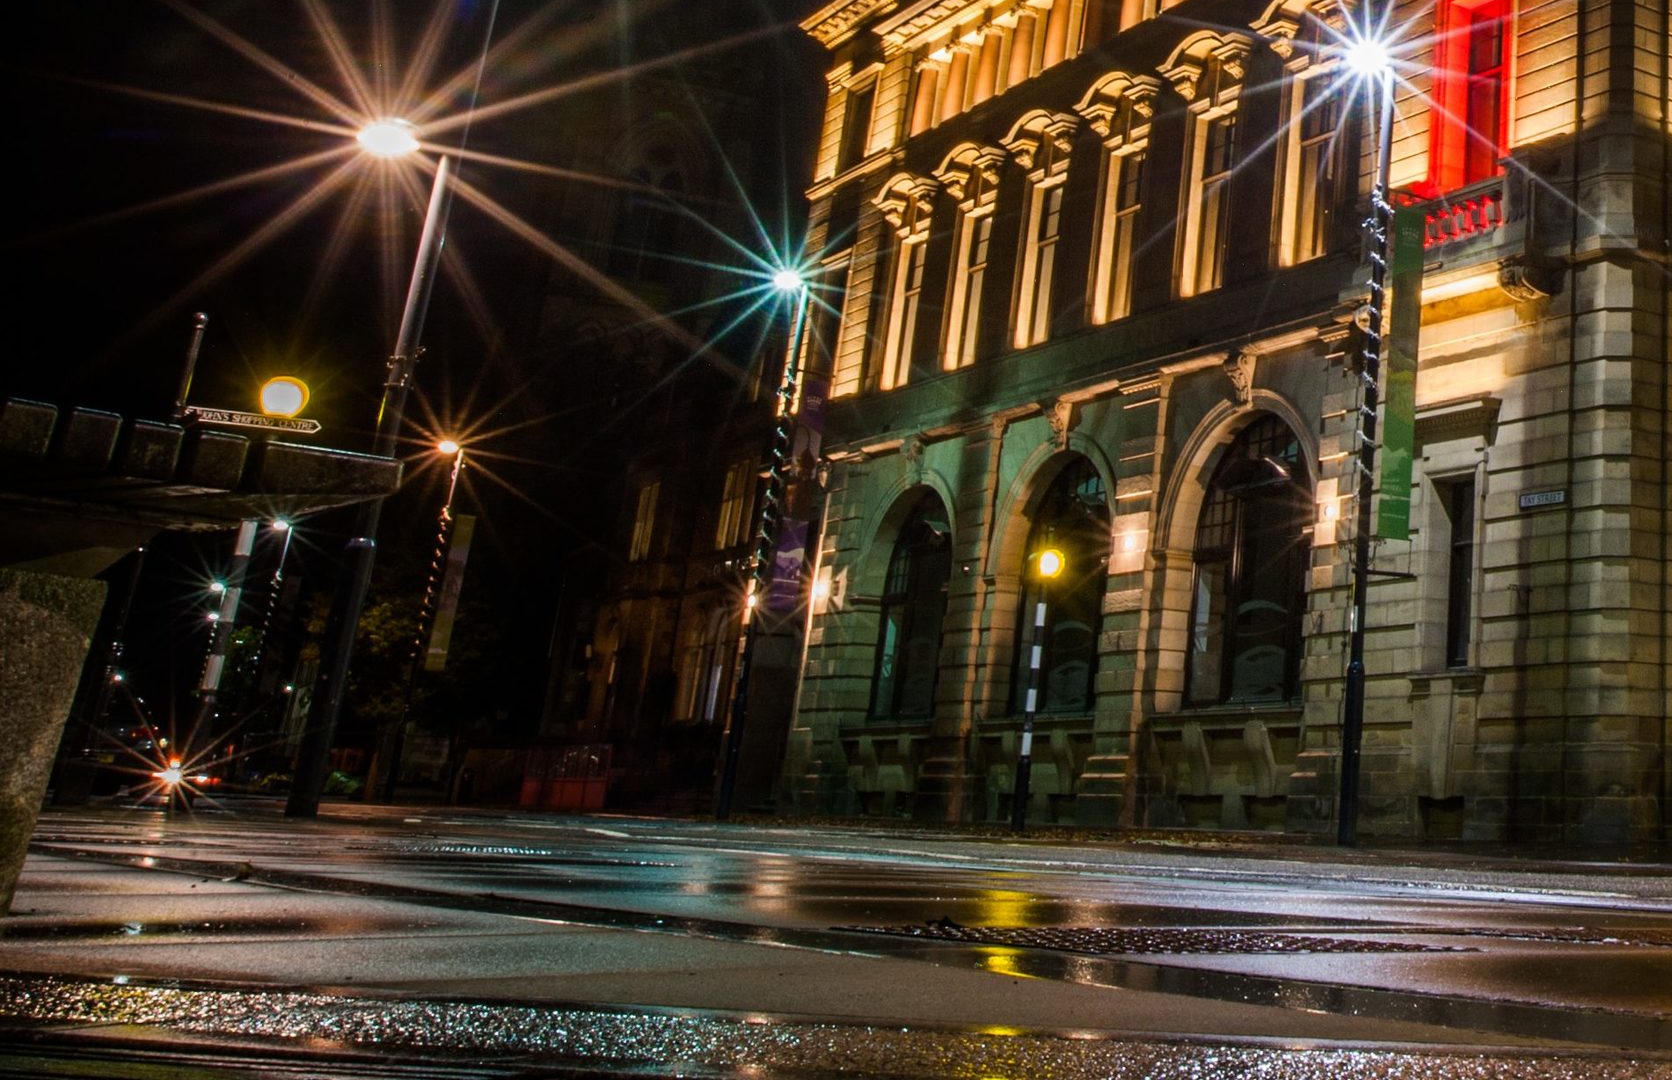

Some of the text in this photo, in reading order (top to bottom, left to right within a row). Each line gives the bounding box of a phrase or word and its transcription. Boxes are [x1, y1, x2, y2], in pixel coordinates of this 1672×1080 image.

[232, 414, 274, 426] SHOPPING
[279, 420, 314, 431] CENTRE
[1537, 492, 1562, 504] STREET
